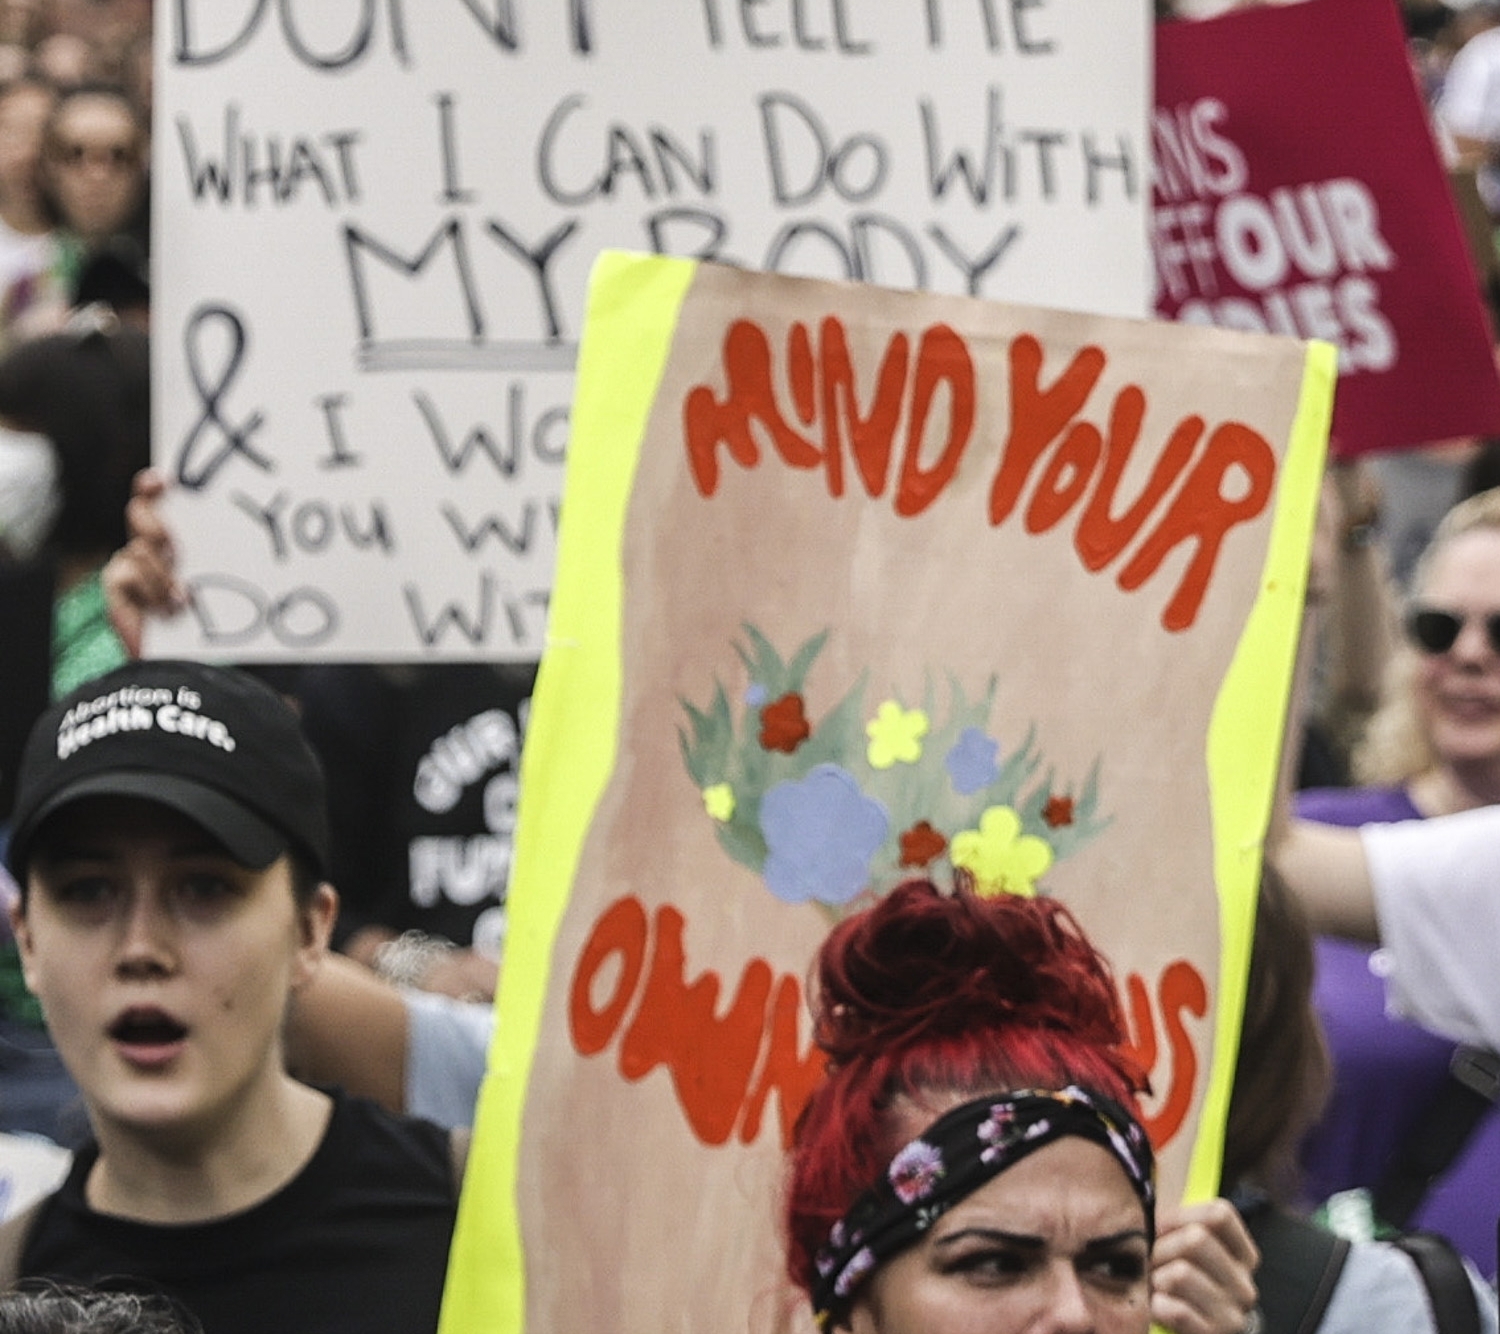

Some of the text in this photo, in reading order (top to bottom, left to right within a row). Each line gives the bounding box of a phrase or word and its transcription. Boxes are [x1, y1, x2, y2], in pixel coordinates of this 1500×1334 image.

[176, 99, 364, 210] WHAT
[431, 92, 476, 205] I
[536, 92, 714, 208] CAN
[761, 92, 886, 208] DO
[343, 218, 579, 346] MY
[1155, 175, 1399, 301] FF OUR
[177, 301, 273, 490] &
[317, 391, 360, 472] I
[683, 315, 1276, 632] MIND YOUR
[187, 571, 339, 649] DO
[57, 704, 236, 760] Health Care.
[58, 684, 173, 734] Abortion
[569, 897, 828, 1148] OWN
